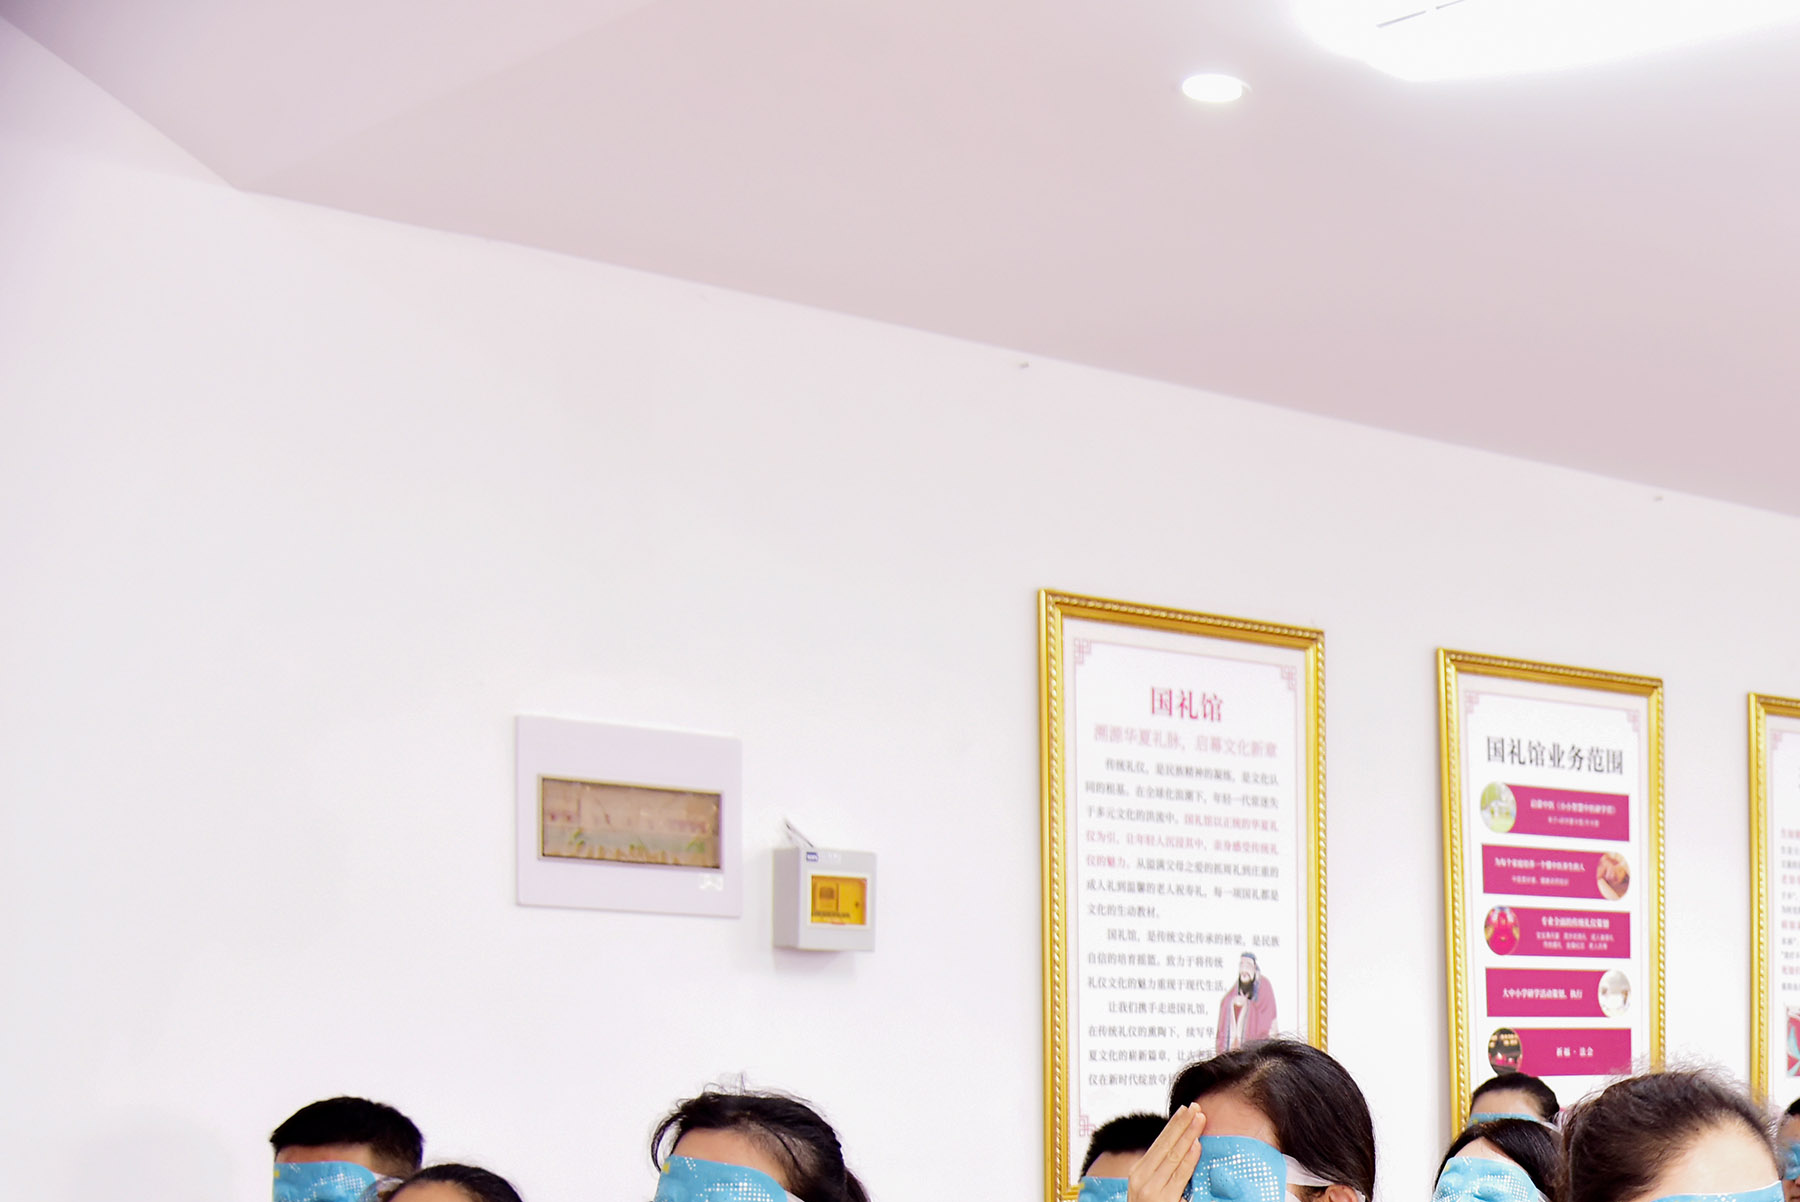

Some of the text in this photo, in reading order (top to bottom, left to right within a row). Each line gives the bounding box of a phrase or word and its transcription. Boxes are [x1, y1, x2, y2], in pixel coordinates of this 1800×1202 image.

[1151, 687, 1223, 722] 国礼馆
[1487, 736, 1623, 775] 国礼馆业务范围
